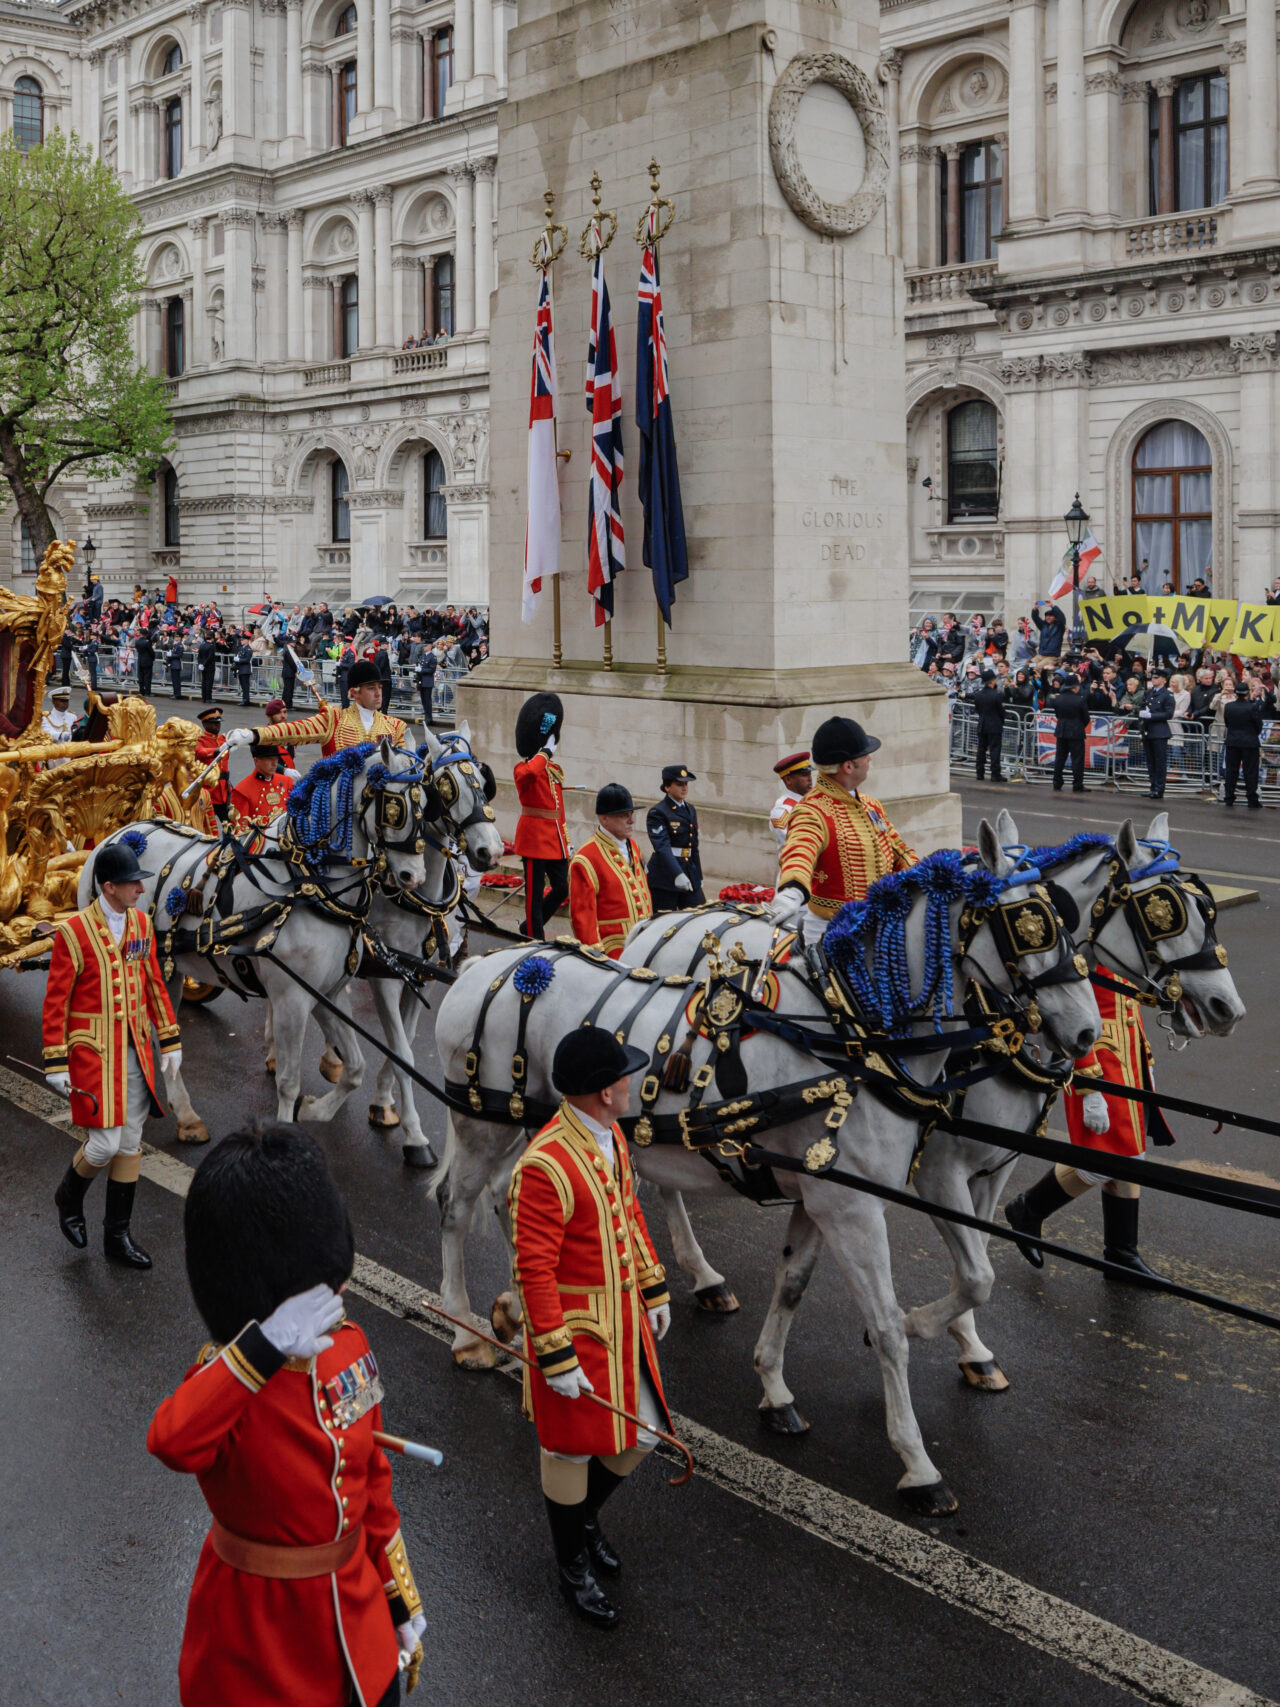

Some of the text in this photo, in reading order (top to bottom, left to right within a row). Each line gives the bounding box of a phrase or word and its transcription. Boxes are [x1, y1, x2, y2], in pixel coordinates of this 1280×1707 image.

[828, 479, 858, 496] THE
[802, 511, 884, 529] GLORIOUS
[821, 544, 866, 561] DEAD
